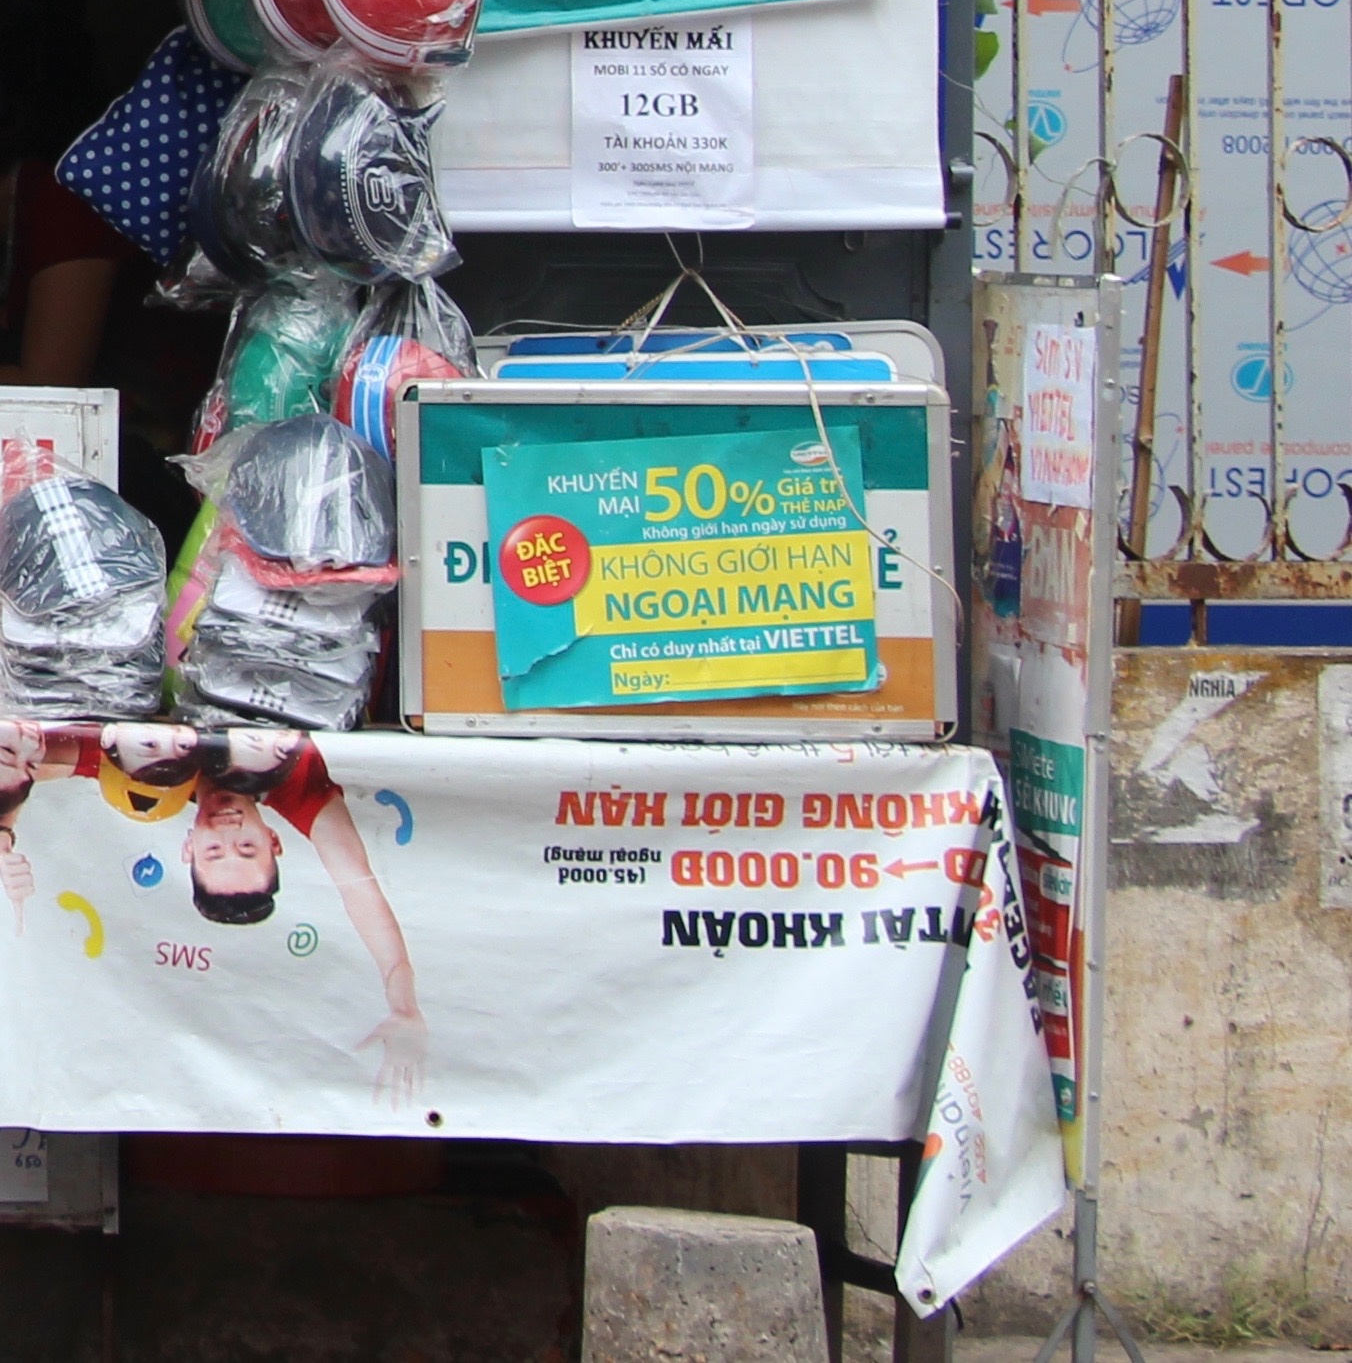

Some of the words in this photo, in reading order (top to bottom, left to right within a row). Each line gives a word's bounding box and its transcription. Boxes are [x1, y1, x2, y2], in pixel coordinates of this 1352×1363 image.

[583, 26, 678, 50] KHUYẾN
[594, 65, 629, 77] MOBI
[632, 65, 646, 76] 11
[649, 61, 667, 77] SỐ
[670, 62, 688, 77] CÓ
[692, 65, 729, 77] NGAY
[620, 92, 700, 118] 12GB
[605, 135, 628, 150] TÀI
[632, 132, 687, 150] KHOẢN
[692, 137, 728, 150] 330K
[547, 468, 639, 496] KHUYẾN
[644, 464, 776, 522] 50%
[777, 476, 816, 497] Giá
[598, 495, 640, 518] MẠI
[780, 498, 811, 515] THẺ
[814, 497, 847, 516] NẠP
[516, 532, 566, 562] ĐẶC
[600, 548, 709, 581] KHÔNG
[717, 542, 778, 574] GIỚI
[788, 541, 852, 575] HẠN
[522, 558, 572, 588] BIỆT
[604, 588, 726, 626] NGOẠI
[737, 578, 855, 621] MẠNG
[613, 671, 671, 691] Ngày:
[556, 784, 669, 826] HẠN
[682, 790, 786, 835] GIỚI
[802, 790, 984, 837] KHÔNG
[609, 848, 662, 866] ngoại
[670, 849, 881, 889] 90.000Đ
[662, 910, 845, 958] KHOẢN
[154, 940, 213, 972] SMS
